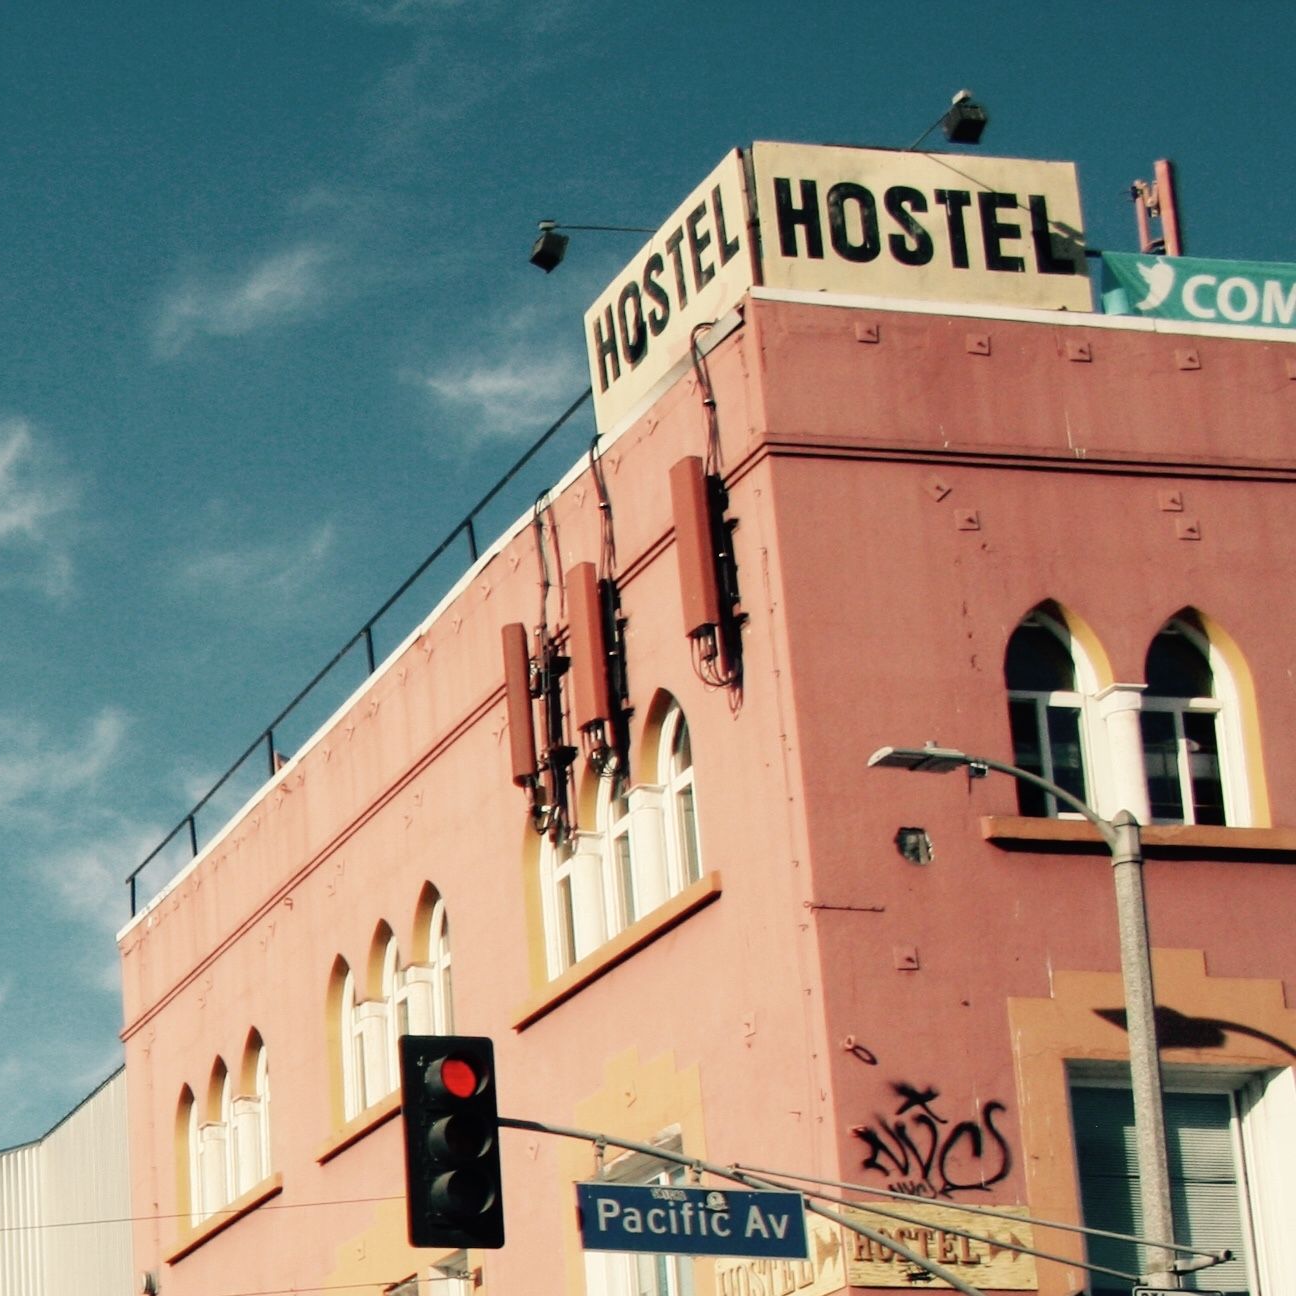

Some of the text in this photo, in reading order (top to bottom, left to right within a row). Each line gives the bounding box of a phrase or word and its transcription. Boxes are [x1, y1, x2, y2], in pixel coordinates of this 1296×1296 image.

[774, 177, 1076, 276] HOSTEL
[591, 183, 740, 394] HOSTEL
[596, 1198, 790, 1240] Pacific Av
[854, 1227, 981, 1264] HOSTEL
